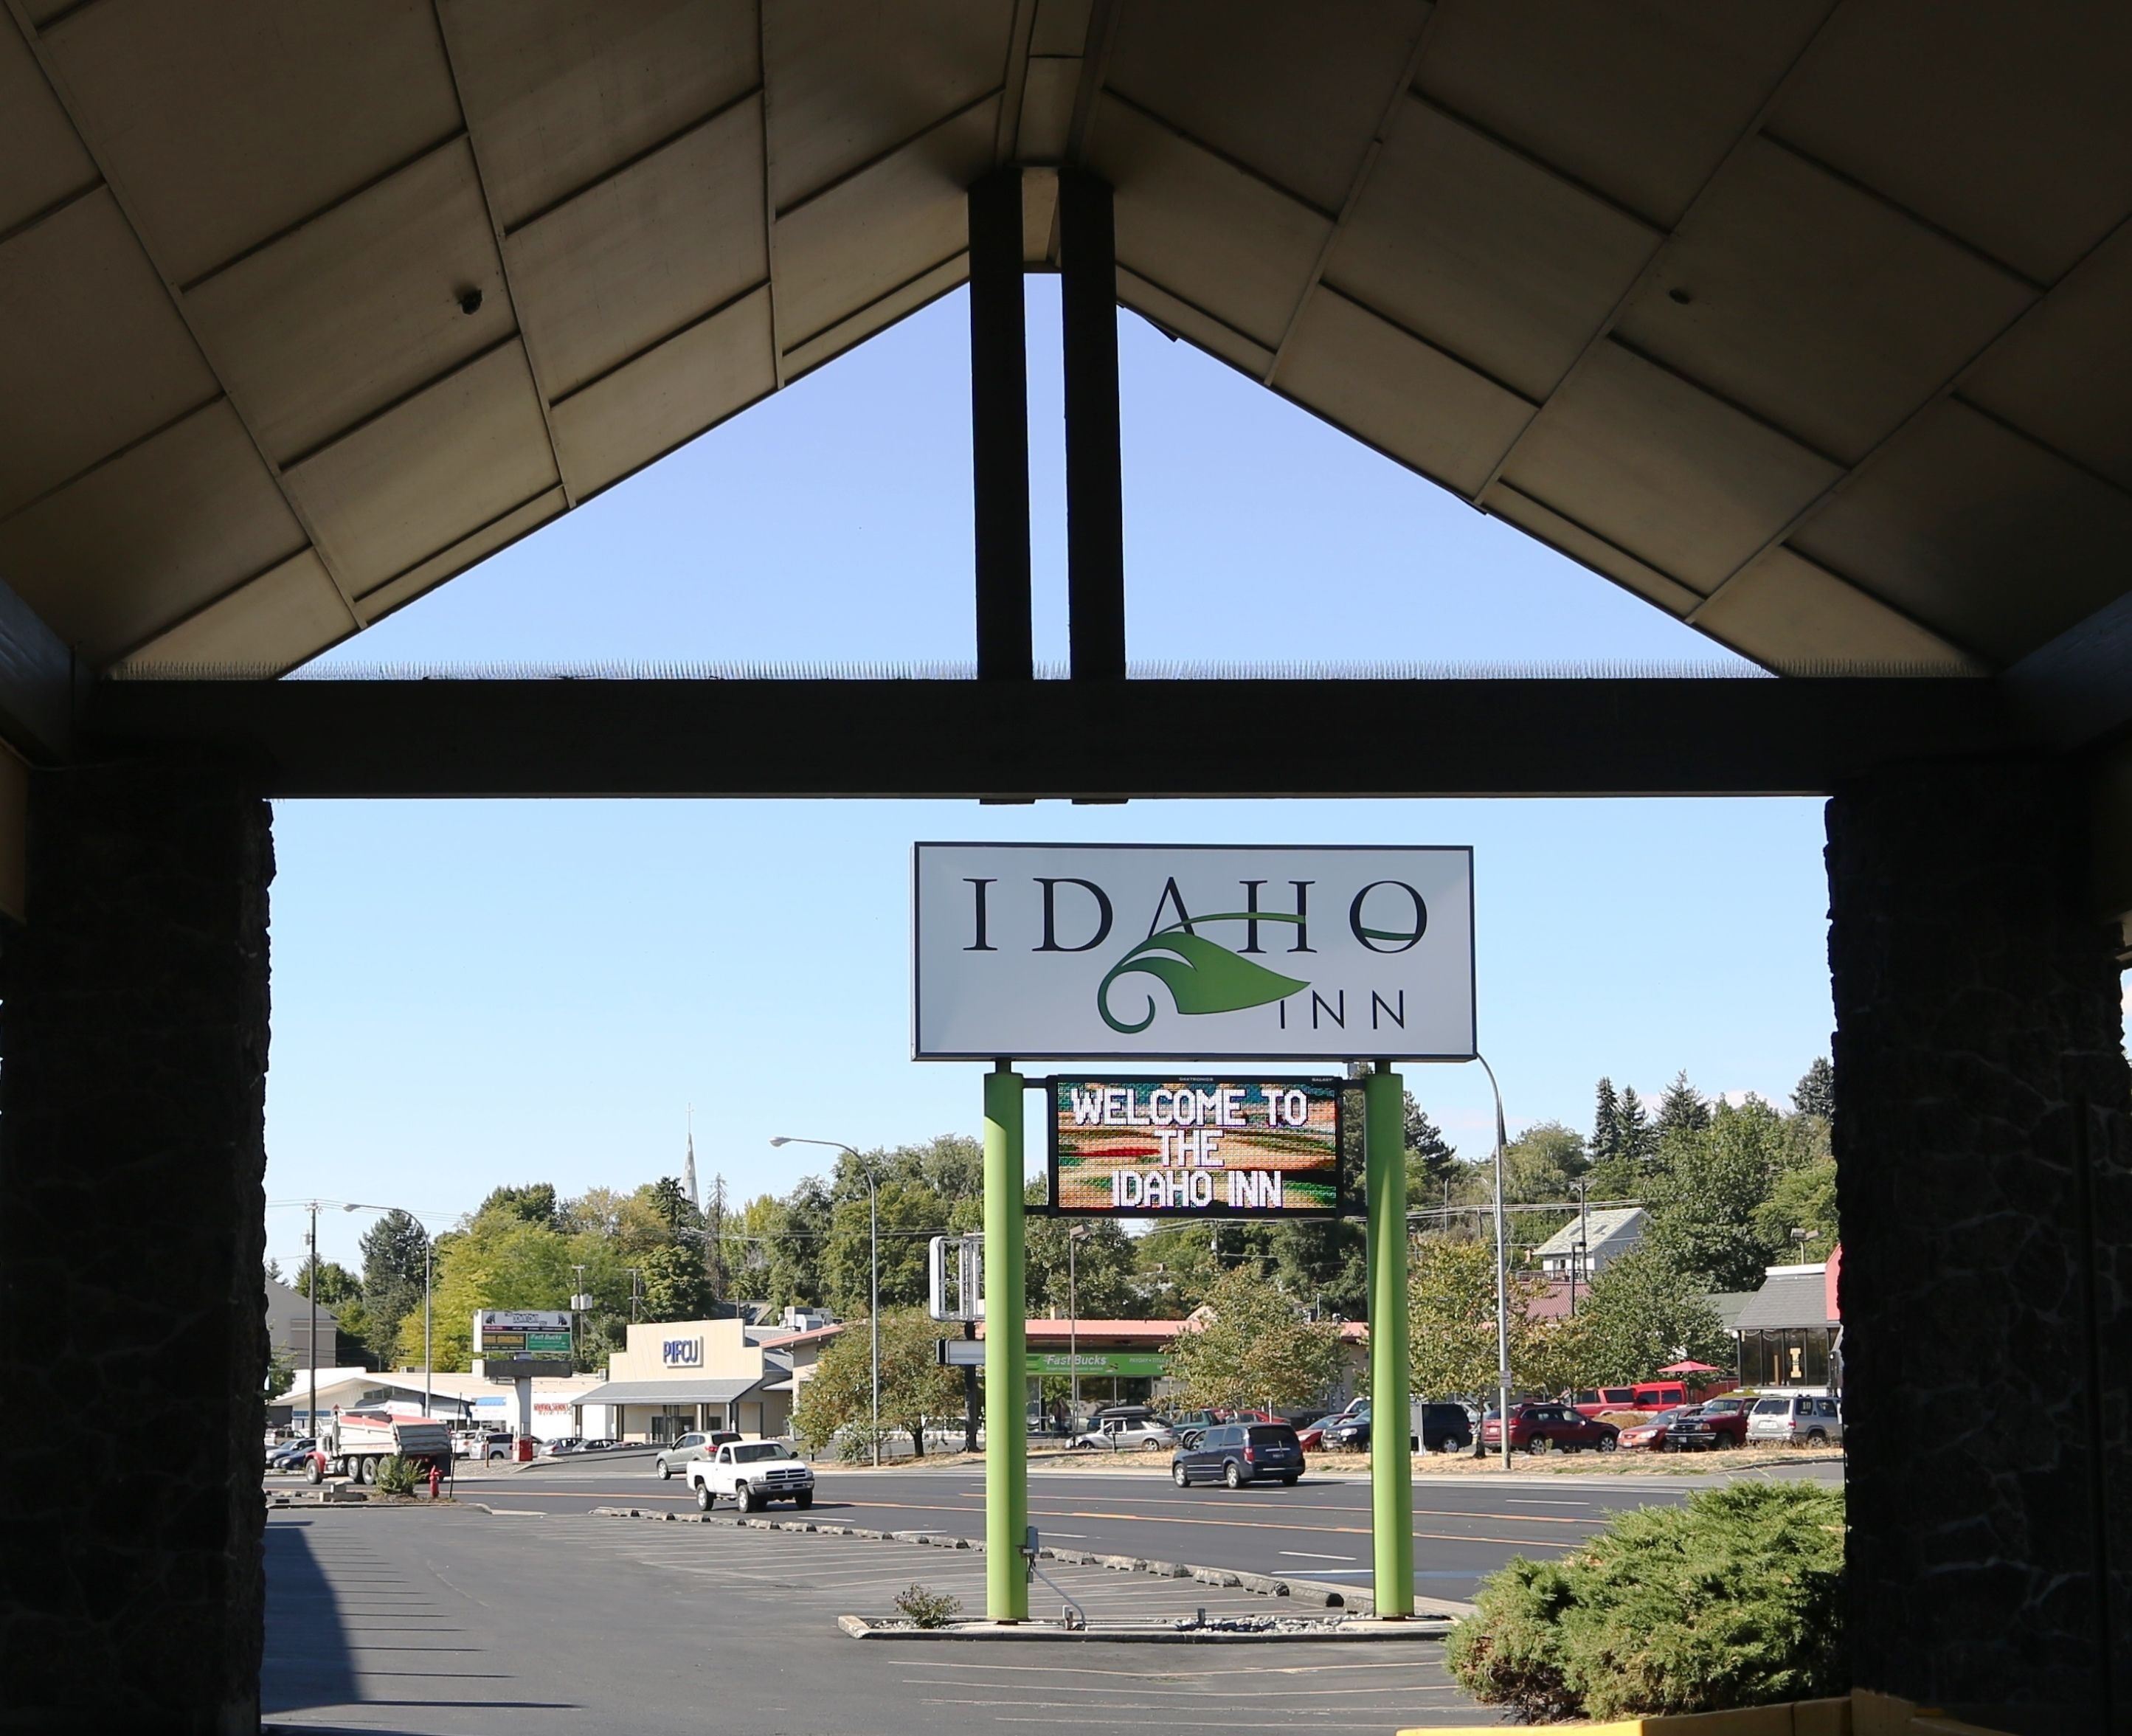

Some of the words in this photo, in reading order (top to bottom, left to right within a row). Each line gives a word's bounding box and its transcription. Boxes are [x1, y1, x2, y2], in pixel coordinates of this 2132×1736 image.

[963, 876, 1427, 954] IDAHO
[1280, 989, 1405, 1031] INN
[1071, 1088, 1247, 1126] WELCOME
[1261, 1088, 1308, 1127] TO
[1155, 1130, 1225, 1167] THE
[1112, 1170, 1214, 1208] IDAHO
[1228, 1170, 1283, 1208] INN
[663, 1340, 698, 1363] PIFCU
[1046, 1355, 1071, 1365] Fast
[1074, 1355, 1107, 1365] Bucks
